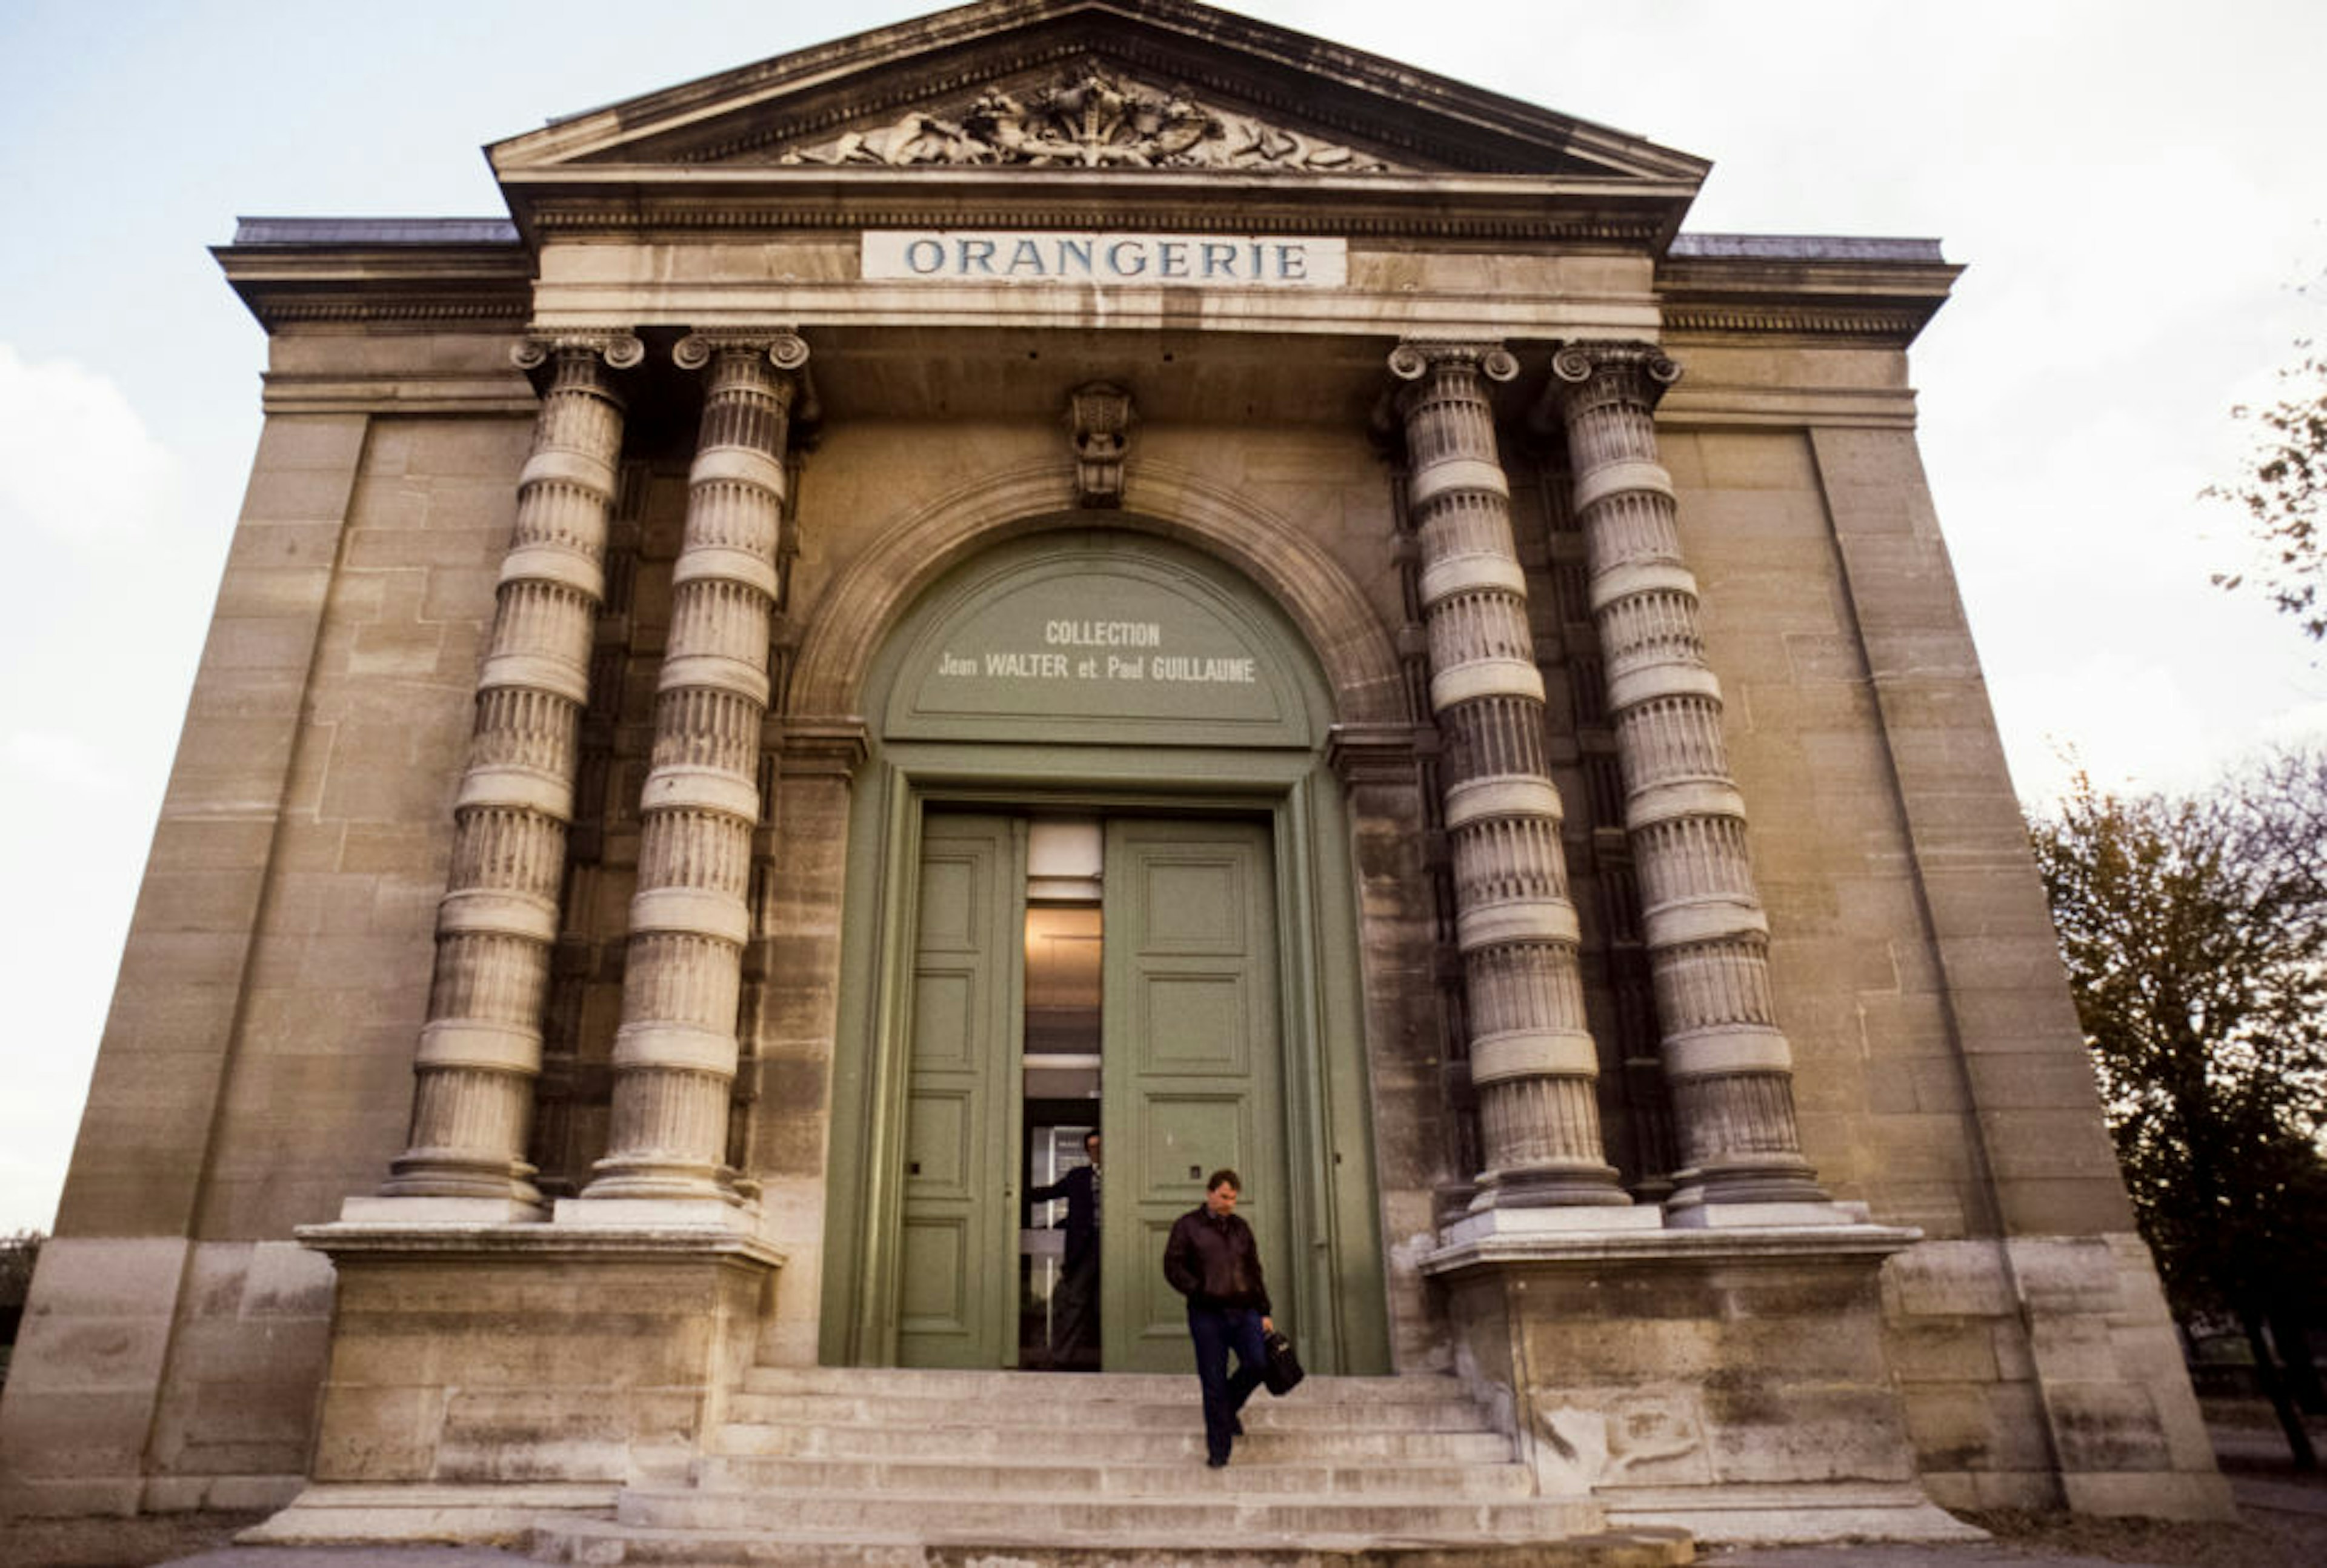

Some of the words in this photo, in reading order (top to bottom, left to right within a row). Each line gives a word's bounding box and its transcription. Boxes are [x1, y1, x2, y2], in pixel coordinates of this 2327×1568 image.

[905, 238, 1309, 281] ORANGERIE
[1046, 620, 1160, 646] COLLECTION
[939, 653, 977, 676] Jean
[985, 654, 1069, 678] WALTER
[1078, 658, 1097, 678] et
[1108, 656, 1144, 679] Paul
[1153, 657, 1256, 683] GUILLAUME
